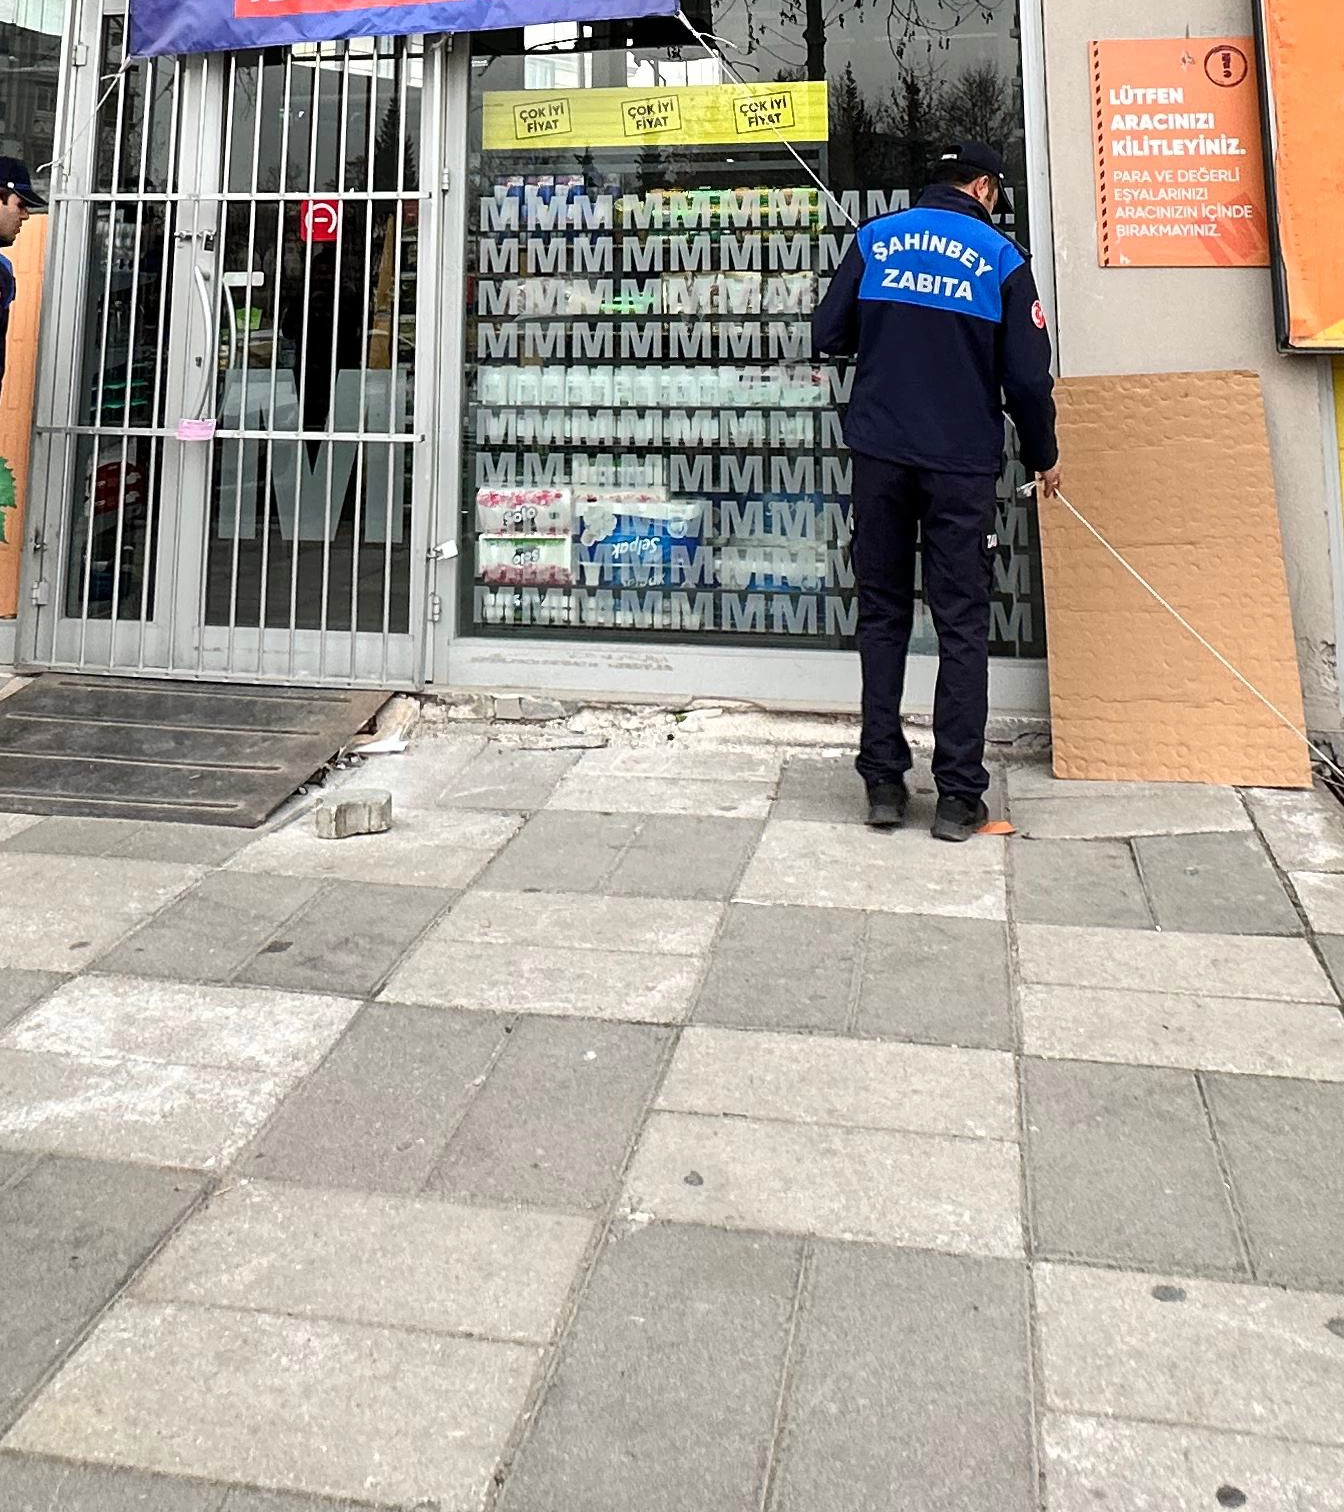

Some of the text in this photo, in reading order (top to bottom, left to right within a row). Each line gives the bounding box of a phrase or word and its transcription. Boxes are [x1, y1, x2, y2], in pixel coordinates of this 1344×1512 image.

[1109, 85, 1184, 105] LÜTFEN
[520, 100, 564, 122] ÇOK İYİ
[628, 97, 674, 118] ÇOK İYİ
[740, 97, 787, 116] ÇOK İYİ
[527, 117, 559, 133] FİYAT
[636, 115, 669, 131] FİYAT
[1110, 112, 1215, 131] ARACINIZI
[1111, 133, 1247, 157] KİLİTLEYİNİZ.
[1113, 167, 1240, 183] PARA VE DEĞERLİ
[1114, 187, 1208, 204] EŞYALARINIZI
[1114, 204, 1253, 222] ARACINIZIN İÇİNDE
[1116, 223, 1221, 238] BIRAKMAYINIZ.
[872, 230, 994, 279] ŞAHİNBEY
[882, 268, 974, 302] ZABITA
[611, 535, 660, 559] Selpak
